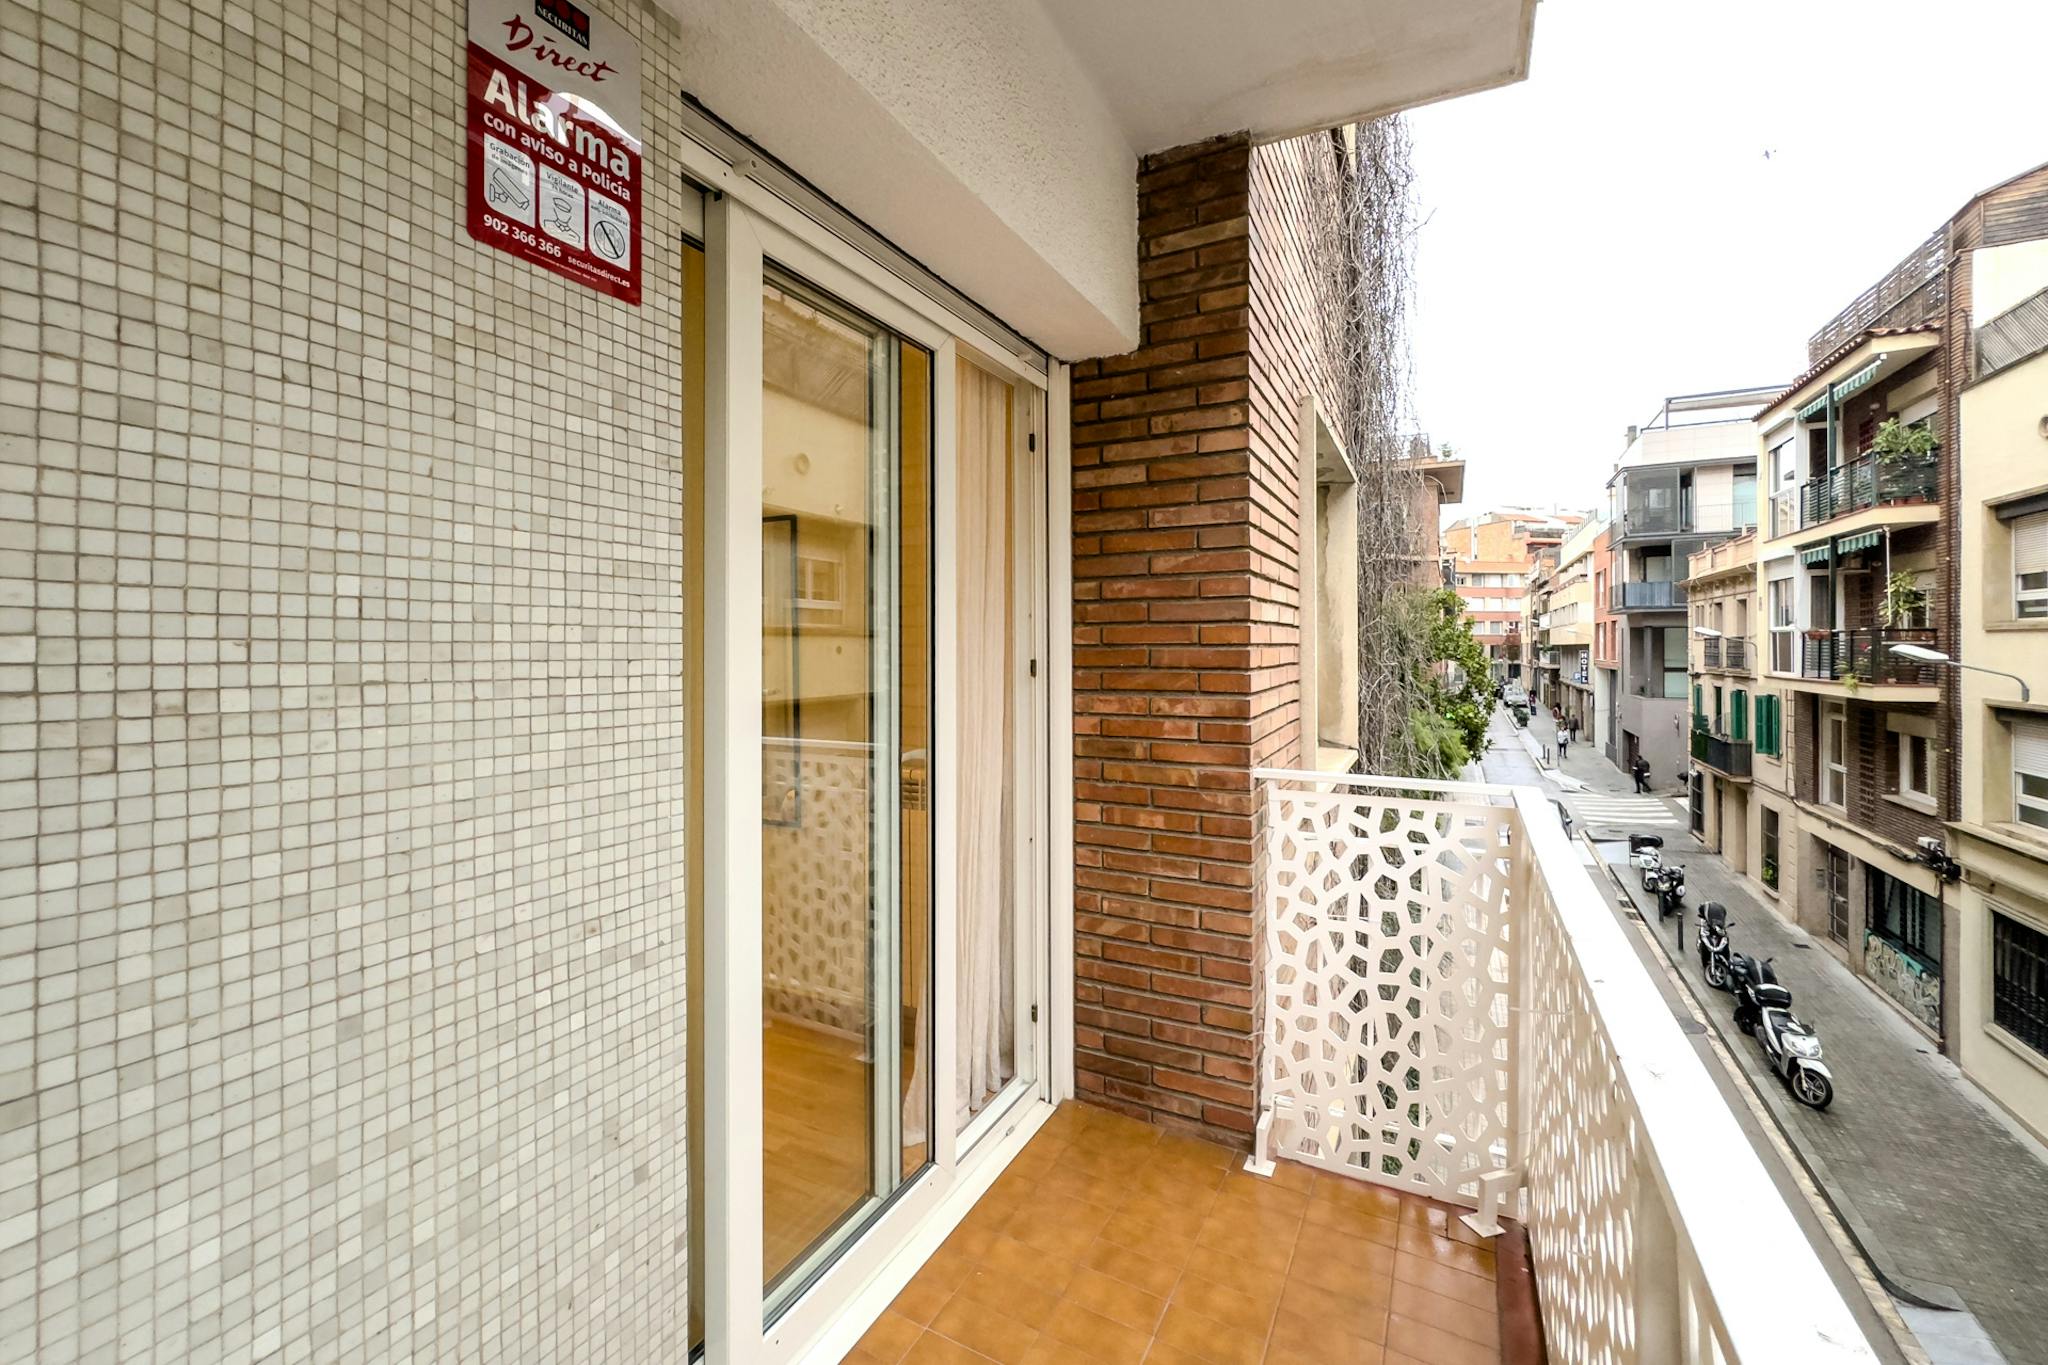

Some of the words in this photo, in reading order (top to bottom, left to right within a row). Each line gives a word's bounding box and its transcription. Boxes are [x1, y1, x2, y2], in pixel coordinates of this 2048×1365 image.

[502, 14, 619, 82] Direct
[537, 5, 588, 47] SECURITAS
[484, 68, 631, 182] Alarma
[483, 111, 516, 139] con
[521, 131, 564, 165] aviso
[568, 159, 578, 173] a
[582, 162, 631, 202] Policía
[546, 171, 579, 194] Vigilante
[483, 214, 509, 236] 902
[512, 226, 536, 247] 366
[539, 238, 562, 258] 366
[567, 255, 631, 289] securitasdirect.es
